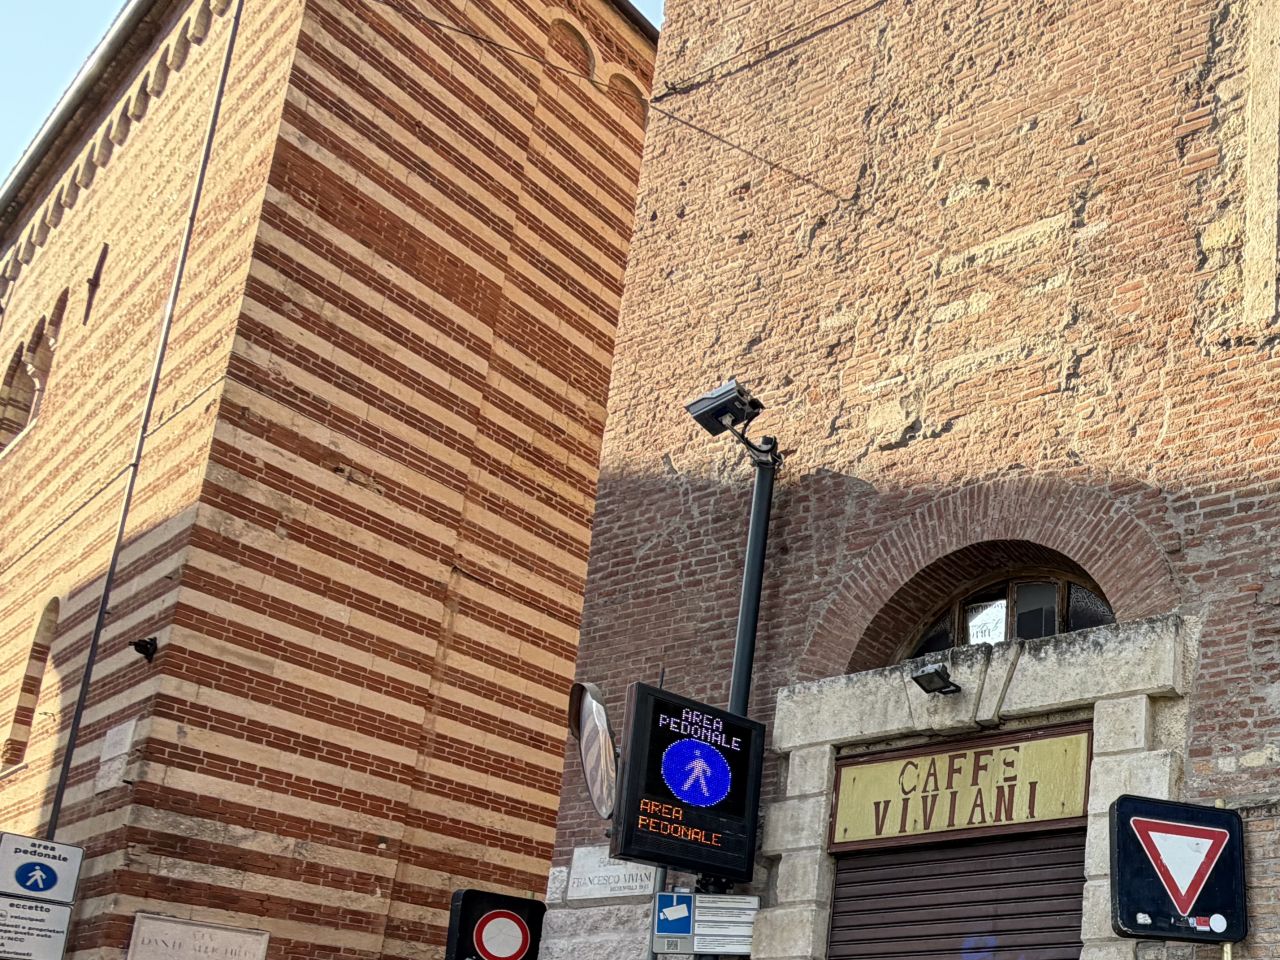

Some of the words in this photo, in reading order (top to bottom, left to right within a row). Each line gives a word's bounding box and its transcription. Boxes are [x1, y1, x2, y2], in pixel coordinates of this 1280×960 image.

[682, 708, 723, 732] AREA
[658, 713, 742, 751] PEDONALE
[899, 745, 1020, 796] CAFFE
[639, 798, 683, 821] AREA
[874, 780, 1039, 836] VIVIANI
[638, 815, 722, 847] PEDONALE
[14, 847, 69, 862] pedonale
[30, 842, 56, 852] area
[571, 874, 621, 888] FRANCESCO
[9, 902, 51, 913] eccetto
